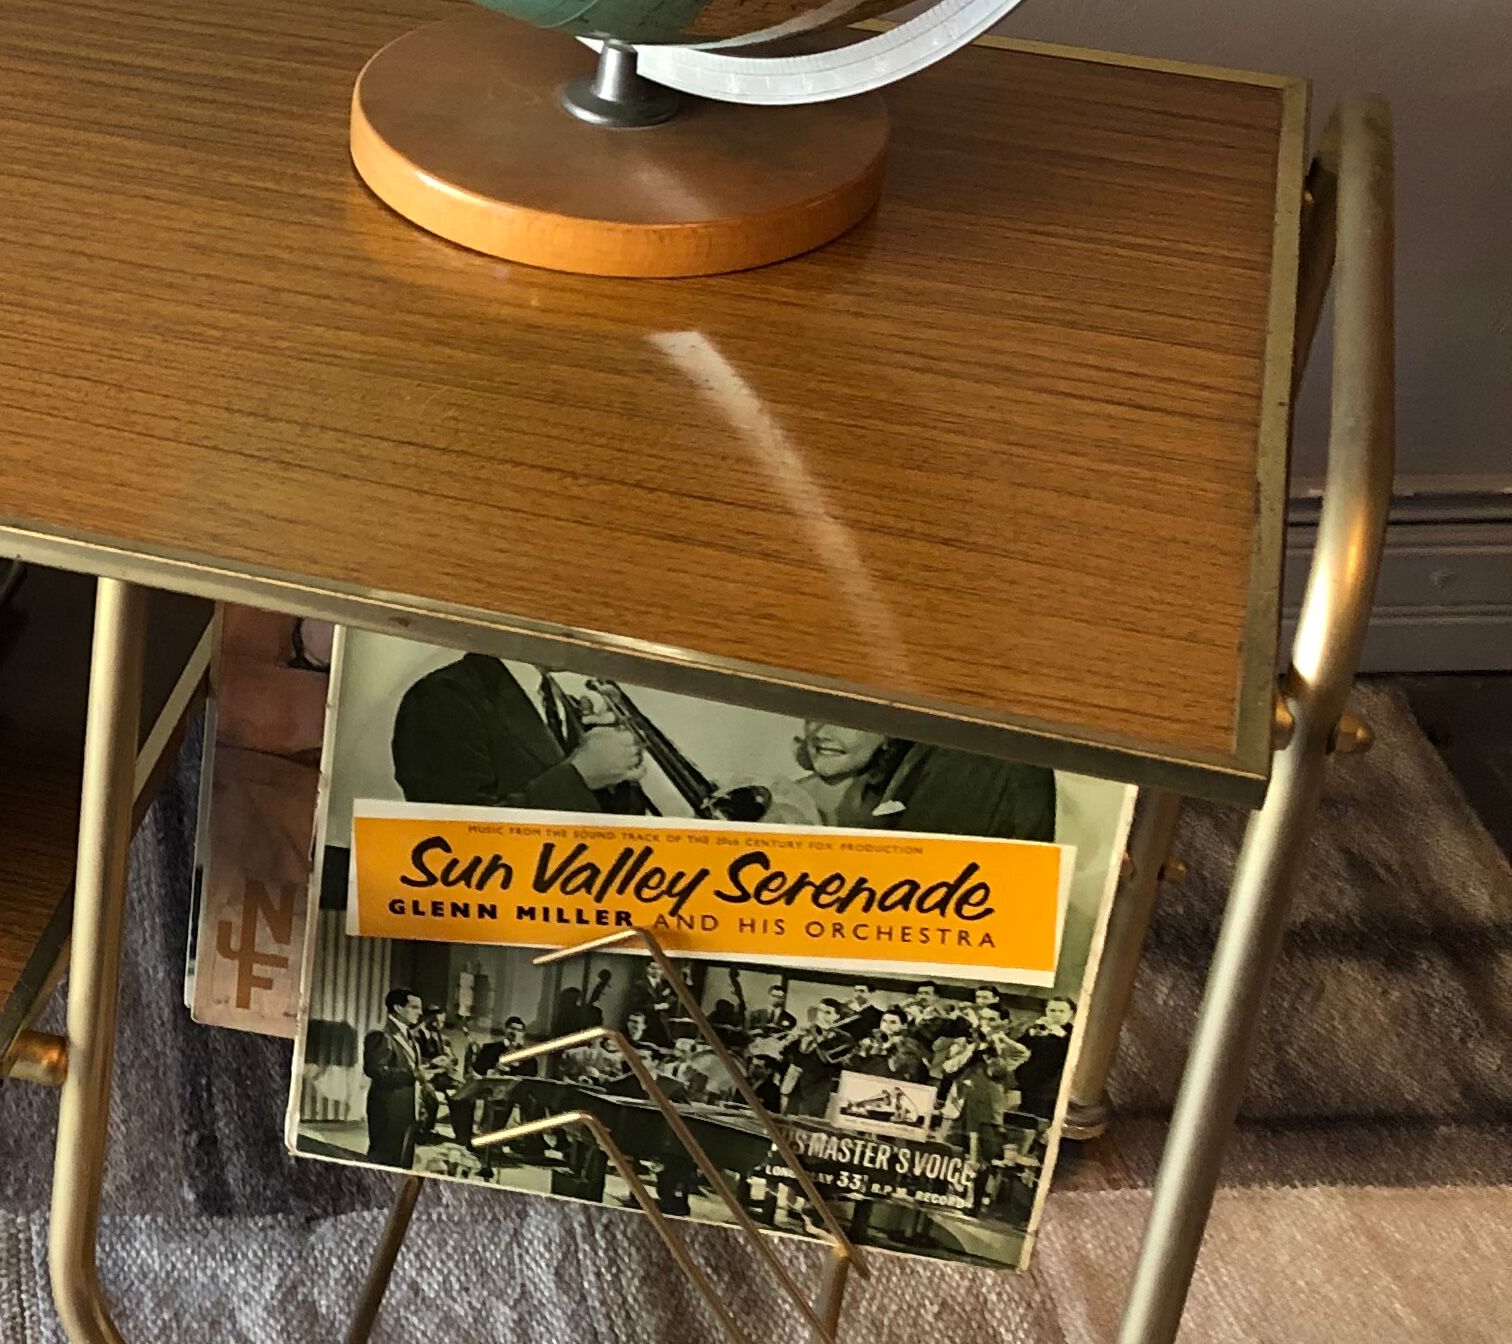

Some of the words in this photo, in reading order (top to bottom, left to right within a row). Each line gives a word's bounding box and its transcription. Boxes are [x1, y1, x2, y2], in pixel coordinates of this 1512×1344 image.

[468, 824, 503, 836] MUSIC
[509, 827, 541, 838] FROM
[545, 828, 568, 839] THE
[573, 829, 616, 841] SOUND
[621, 832, 660, 843] TRACK
[666, 834, 682, 844] OF
[687, 835, 710, 845] THE
[744, 838, 803, 850] CENTURY
[809, 841, 832, 851] FOX
[840, 842, 924, 855] PRODUCTION
[400, 835, 513, 891] Sun
[532, 841, 711, 918] Valley
[713, 850, 995, 922] Serenade
[388, 898, 498, 920] GLENN
[515, 905, 634, 927] MILLER
[653, 913, 719, 932] AND
[738, 916, 786, 936] HIS
[804, 919, 996, 949] ORCHESTRA
[913, 1150, 977, 1186] VOICE
